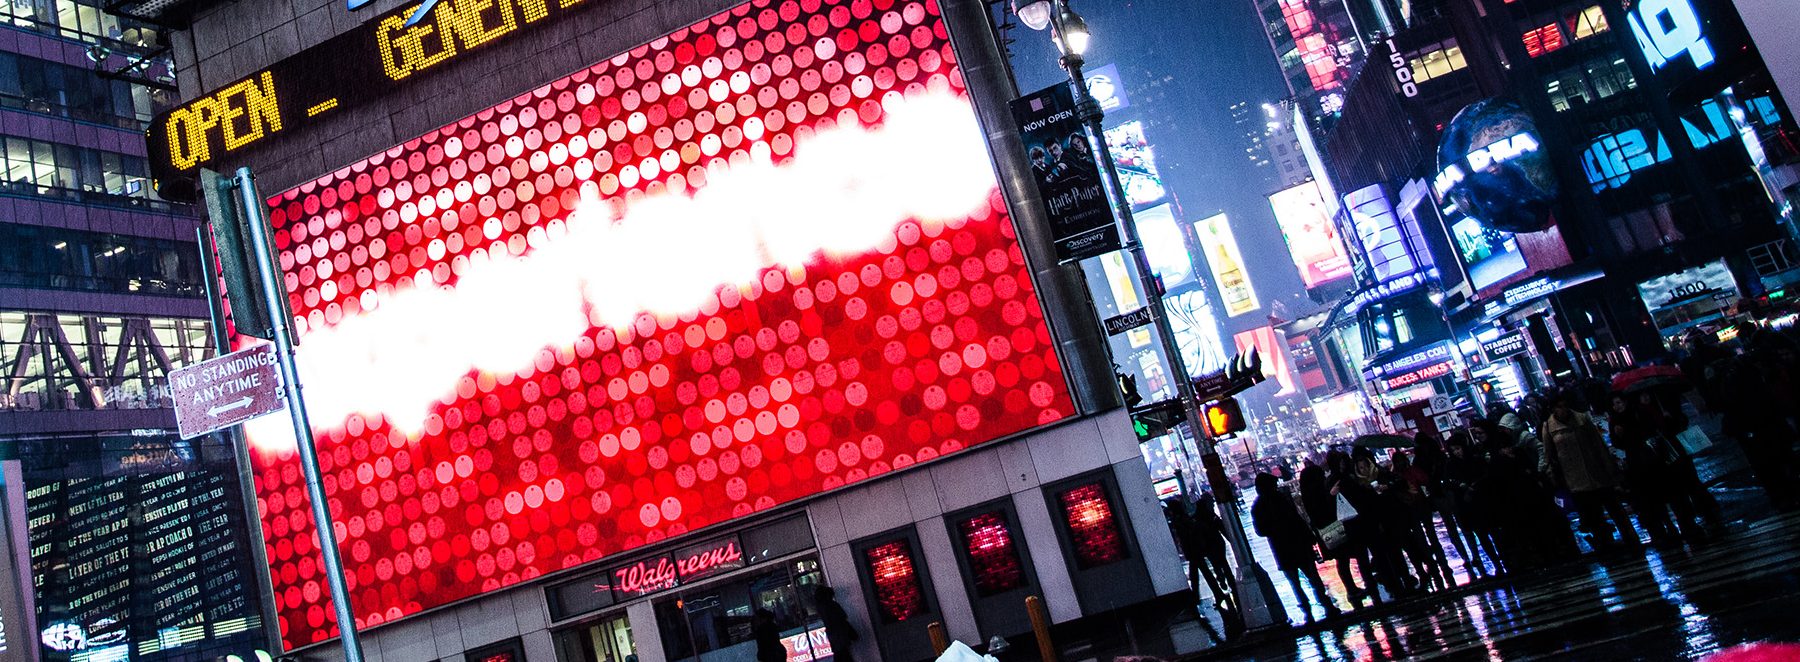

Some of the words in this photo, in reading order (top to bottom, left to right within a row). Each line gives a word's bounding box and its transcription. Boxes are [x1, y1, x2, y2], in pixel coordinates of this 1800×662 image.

[1386, 39, 1418, 98] 1500
[166, 71, 282, 171] OPEN
[1023, 119, 1046, 133] NOW
[1047, 109, 1073, 124] OPEN
[1668, 280, 1707, 299] 1500
[1107, 310, 1149, 331] LINCOLN
[1483, 333, 1522, 352] STARBUCK
[1493, 341, 1522, 355] COFFEE
[177, 373, 197, 390] NO
[202, 352, 267, 383] STANDING
[1416, 362, 1449, 380] YANKS
[193, 373, 261, 404] ANYTIME
[27, 484, 52, 500] ROUND
[615, 542, 742, 593] Walgreens
[819, 646, 833, 658] hou
